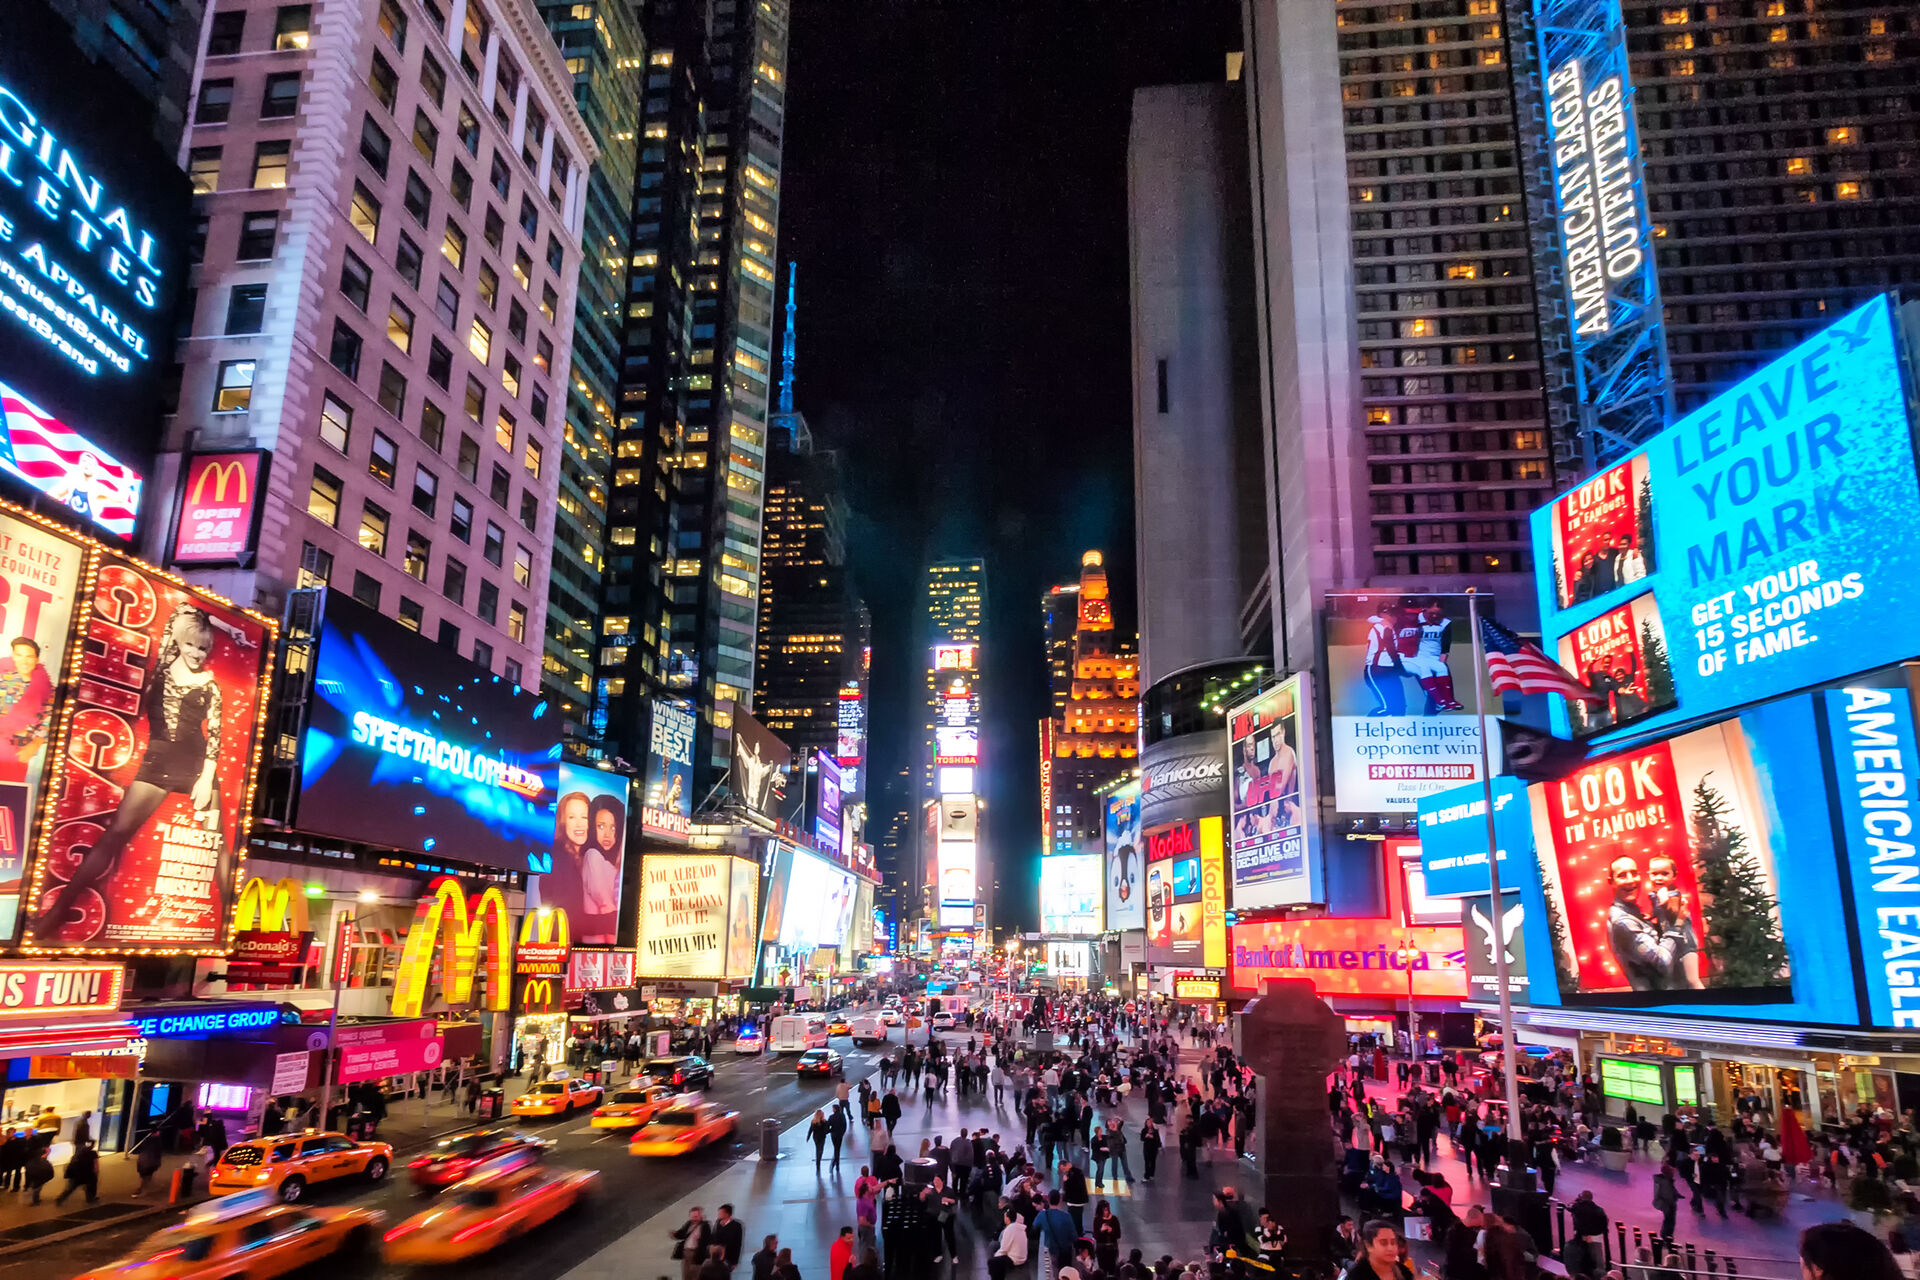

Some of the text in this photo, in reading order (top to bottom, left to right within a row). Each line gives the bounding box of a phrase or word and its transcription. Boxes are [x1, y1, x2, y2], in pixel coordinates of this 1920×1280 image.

[1587, 78, 1642, 280] OUTFITTERS
[1547, 59, 1609, 336] AMERICAN EAGLE
[20, 242, 149, 360] APPAREL
[1673, 342, 1839, 477] LEAVE
[1693, 412, 1848, 521] YOUR
[1567, 466, 1626, 518] LOOK
[192, 508, 242, 520] OPEN
[194, 520, 234, 540] 24
[1686, 474, 1855, 589] MARK
[18, 542, 61, 571] GLITZ
[181, 541, 242, 554] HOURS
[1691, 559, 1821, 627] GET YOUR
[1694, 572, 1865, 652] 15 SECONDS
[1577, 611, 1629, 651] LOOK
[1698, 620, 1819, 677] OF FAME.
[651, 699, 696, 730] WINNER!
[651, 721, 693, 755] BEST
[1355, 721, 1417, 741] Helped
[40, 563, 158, 943] CHICAGO
[650, 741, 692, 766] MUSICAL
[937, 755, 977, 764] TOSHIBA
[1356, 740, 1483, 759] opponent win.
[1371, 765, 1473, 779] SPORTSMANSHIP
[1246, 769, 1284, 808] UFC
[1397, 781, 1447, 792] Pass It On.
[1560, 756, 1664, 819] LOOK
[642, 805, 691, 834] MEMPHIS
[1438, 799, 1489, 824] SCOTLAN
[1592, 804, 1666, 838] FAMOUS!
[160, 842, 219, 868] RUNNING
[1149, 823, 1194, 862] Kodak
[1258, 843, 1281, 859] LIVE
[1282, 838, 1301, 853] ON
[158, 860, 216, 882] AMERICAN
[1842, 686, 1920, 1029] AMERICAN EAGLE
[650, 863, 717, 884] YOU ALREADY
[154, 876, 212, 900] MUSICAL
[669, 881, 699, 897] KNOW
[1203, 857, 1223, 928] Kodak
[648, 894, 723, 914] YOU'RE GONNA
[665, 909, 709, 928] LOVE IT!
[517, 947, 566, 956] McDonald's
[648, 933, 717, 956] MAMMA MIA!
[1236, 943, 1430, 970] Bank of America
[34, 971, 102, 1006] FUN!
[160, 1014, 225, 1034] CHANGE
[228, 1010, 278, 1028] GROUP
[345, 1058, 400, 1075] VISITOR CENTER
[347, 1049, 397, 1064] TIMES SQUARE
